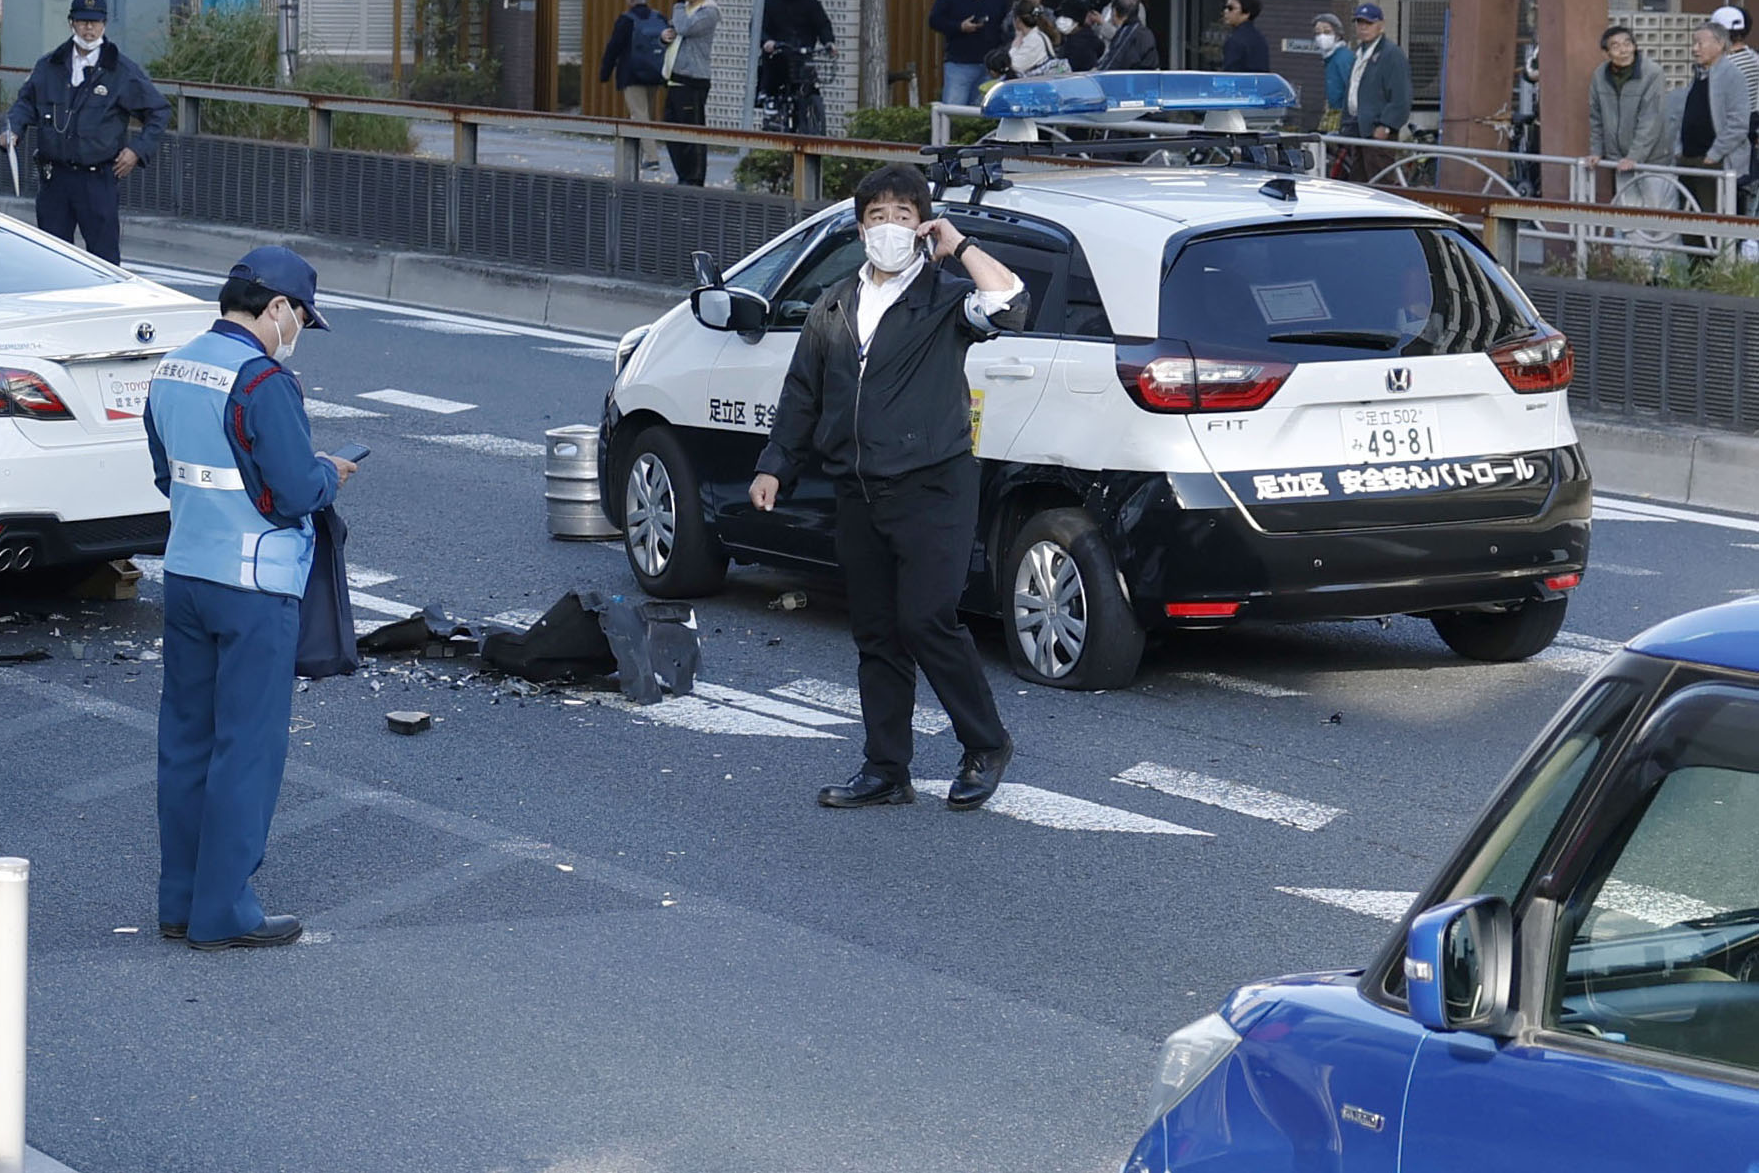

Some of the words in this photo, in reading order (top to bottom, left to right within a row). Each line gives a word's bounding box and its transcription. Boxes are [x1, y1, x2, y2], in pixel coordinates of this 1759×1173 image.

[124, 380, 150, 392] TOYO
[709, 398, 746, 426] 足立区
[1207, 419, 1249, 431] FIT
[1352, 438, 1363, 451] み
[1368, 427, 1434, 457] 49-81
[1252, 472, 1329, 500] 足立区
[1338, 457, 1536, 496] 安全安心パトロール
